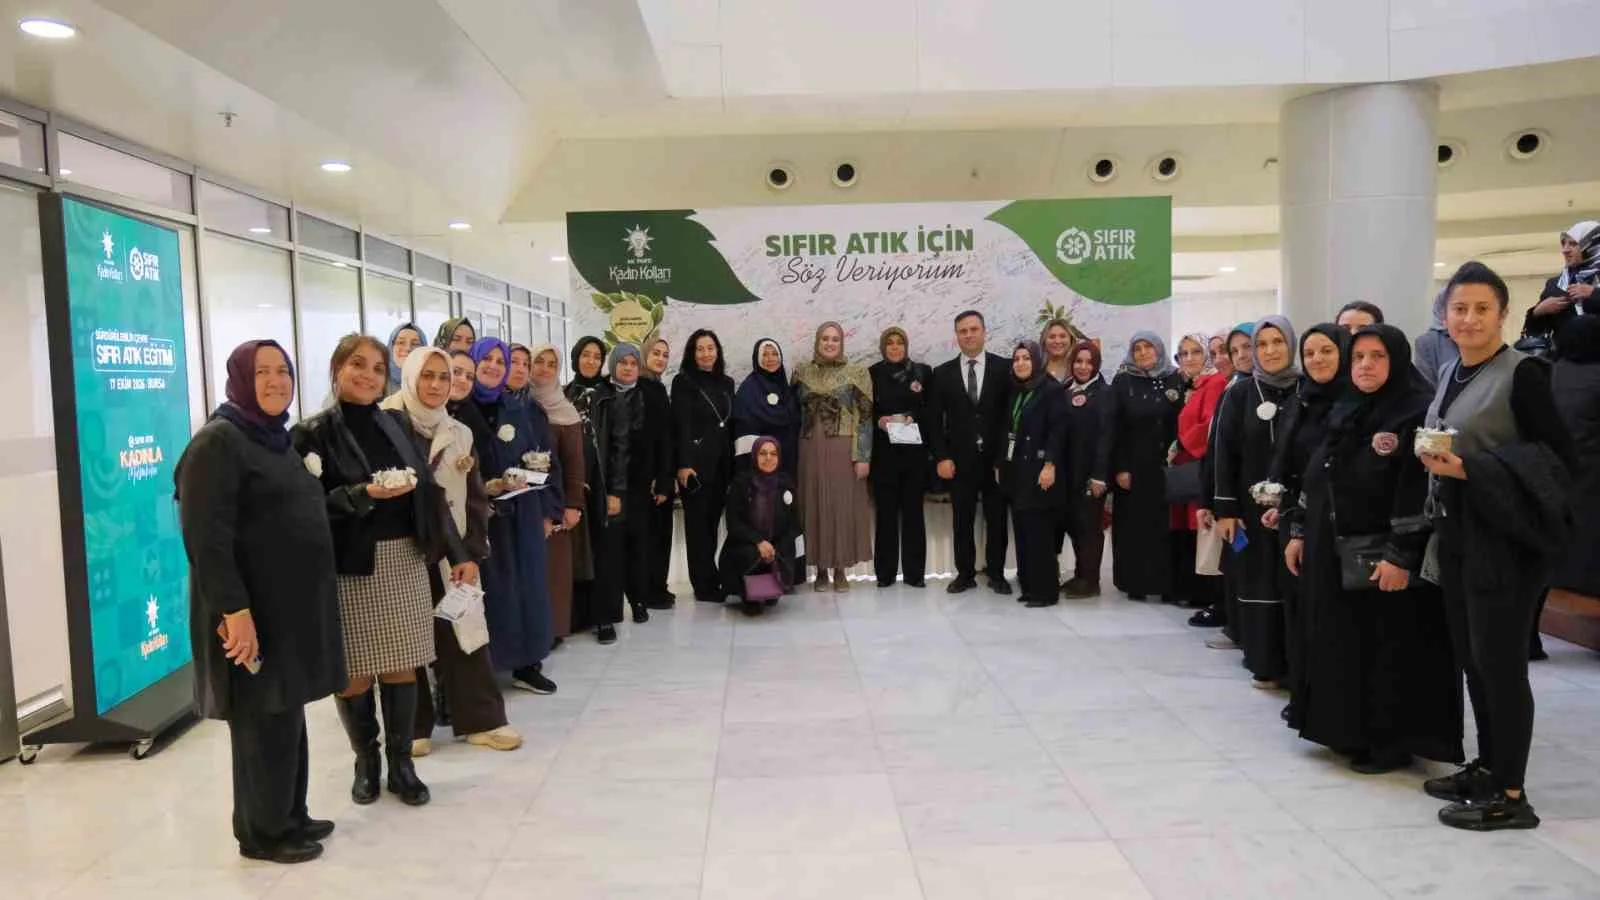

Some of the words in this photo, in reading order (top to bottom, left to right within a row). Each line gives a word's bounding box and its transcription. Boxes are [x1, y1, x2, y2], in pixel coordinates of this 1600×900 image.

[765, 234, 837, 257] SIFIR
[846, 232, 909, 254] ATIK
[917, 224, 974, 258] İÇİN
[1093, 229, 1136, 244] SIFIR
[1094, 244, 1136, 260] ATIK
[609, 266, 638, 285] Kadın
[640, 265, 672, 281] Kolları
[781, 256, 826, 294] Söz
[836, 255, 965, 291] Veriyorum
[96, 344, 120, 365] SIFIR
[122, 346, 142, 365] ATIK
